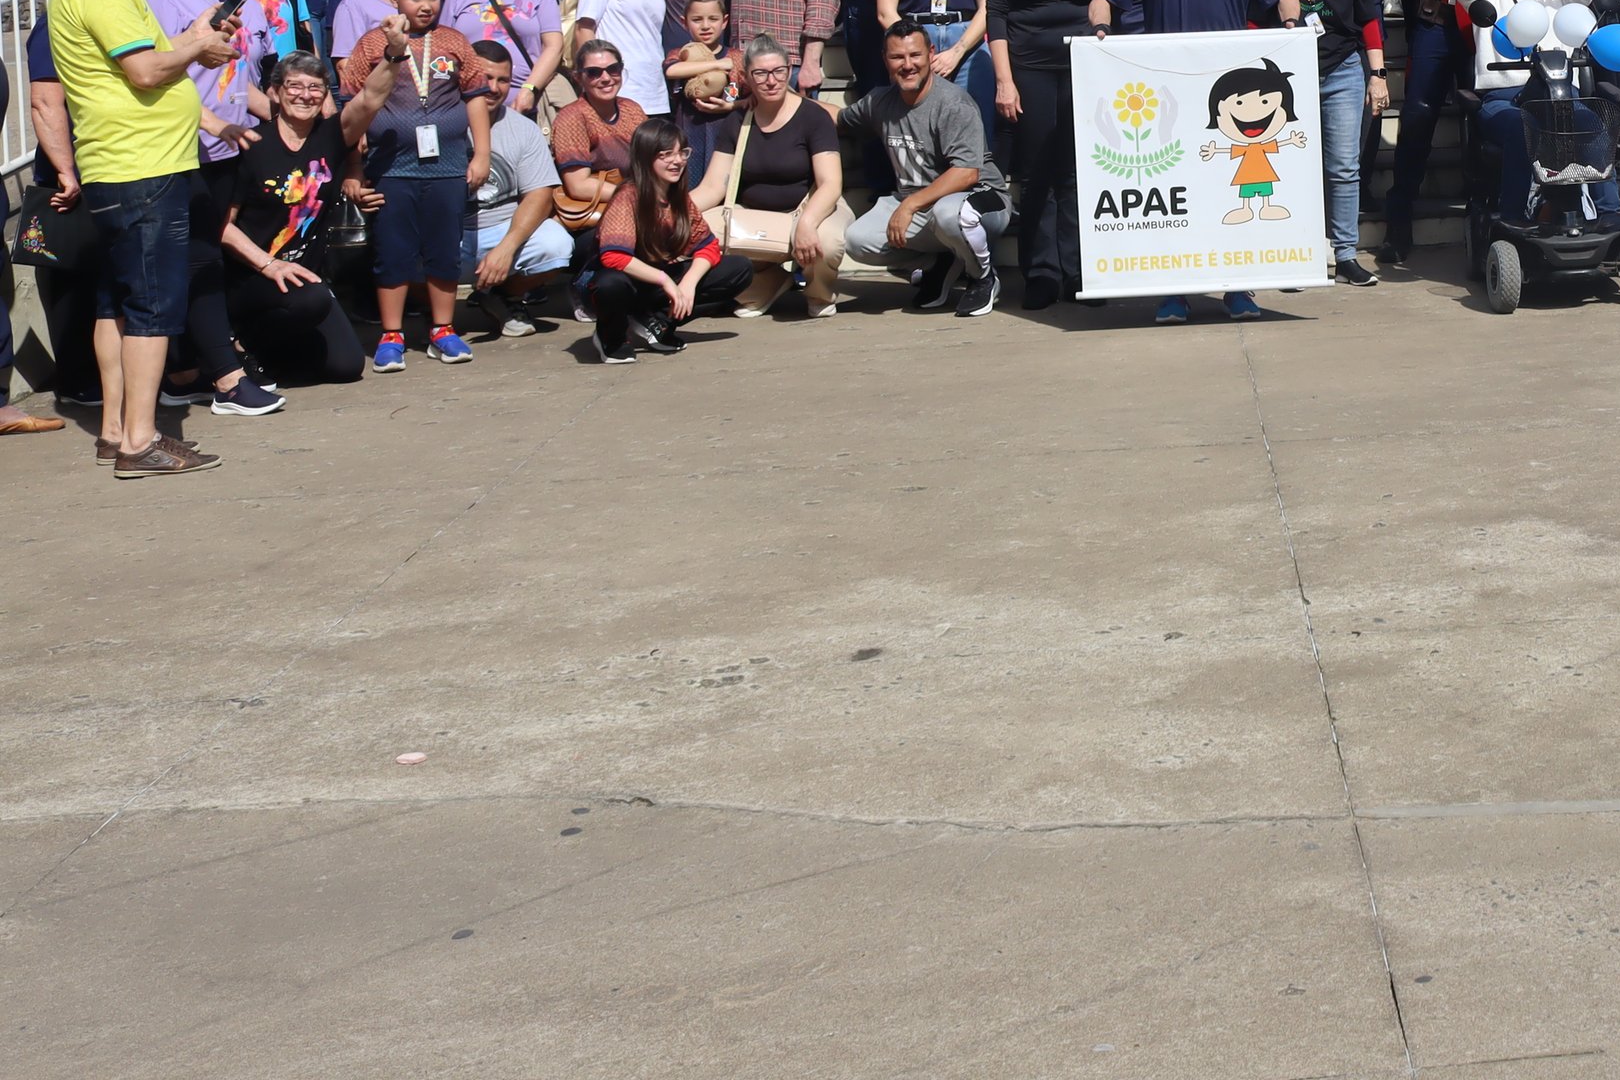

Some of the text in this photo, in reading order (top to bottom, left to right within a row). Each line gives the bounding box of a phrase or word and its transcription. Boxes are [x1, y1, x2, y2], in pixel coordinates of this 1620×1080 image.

[1093, 186, 1188, 220] APAE
[1094, 219, 1189, 232] NOVO HAMBURGO
[1097, 247, 1313, 272] O DIFERENTE É SER IGUAL!
